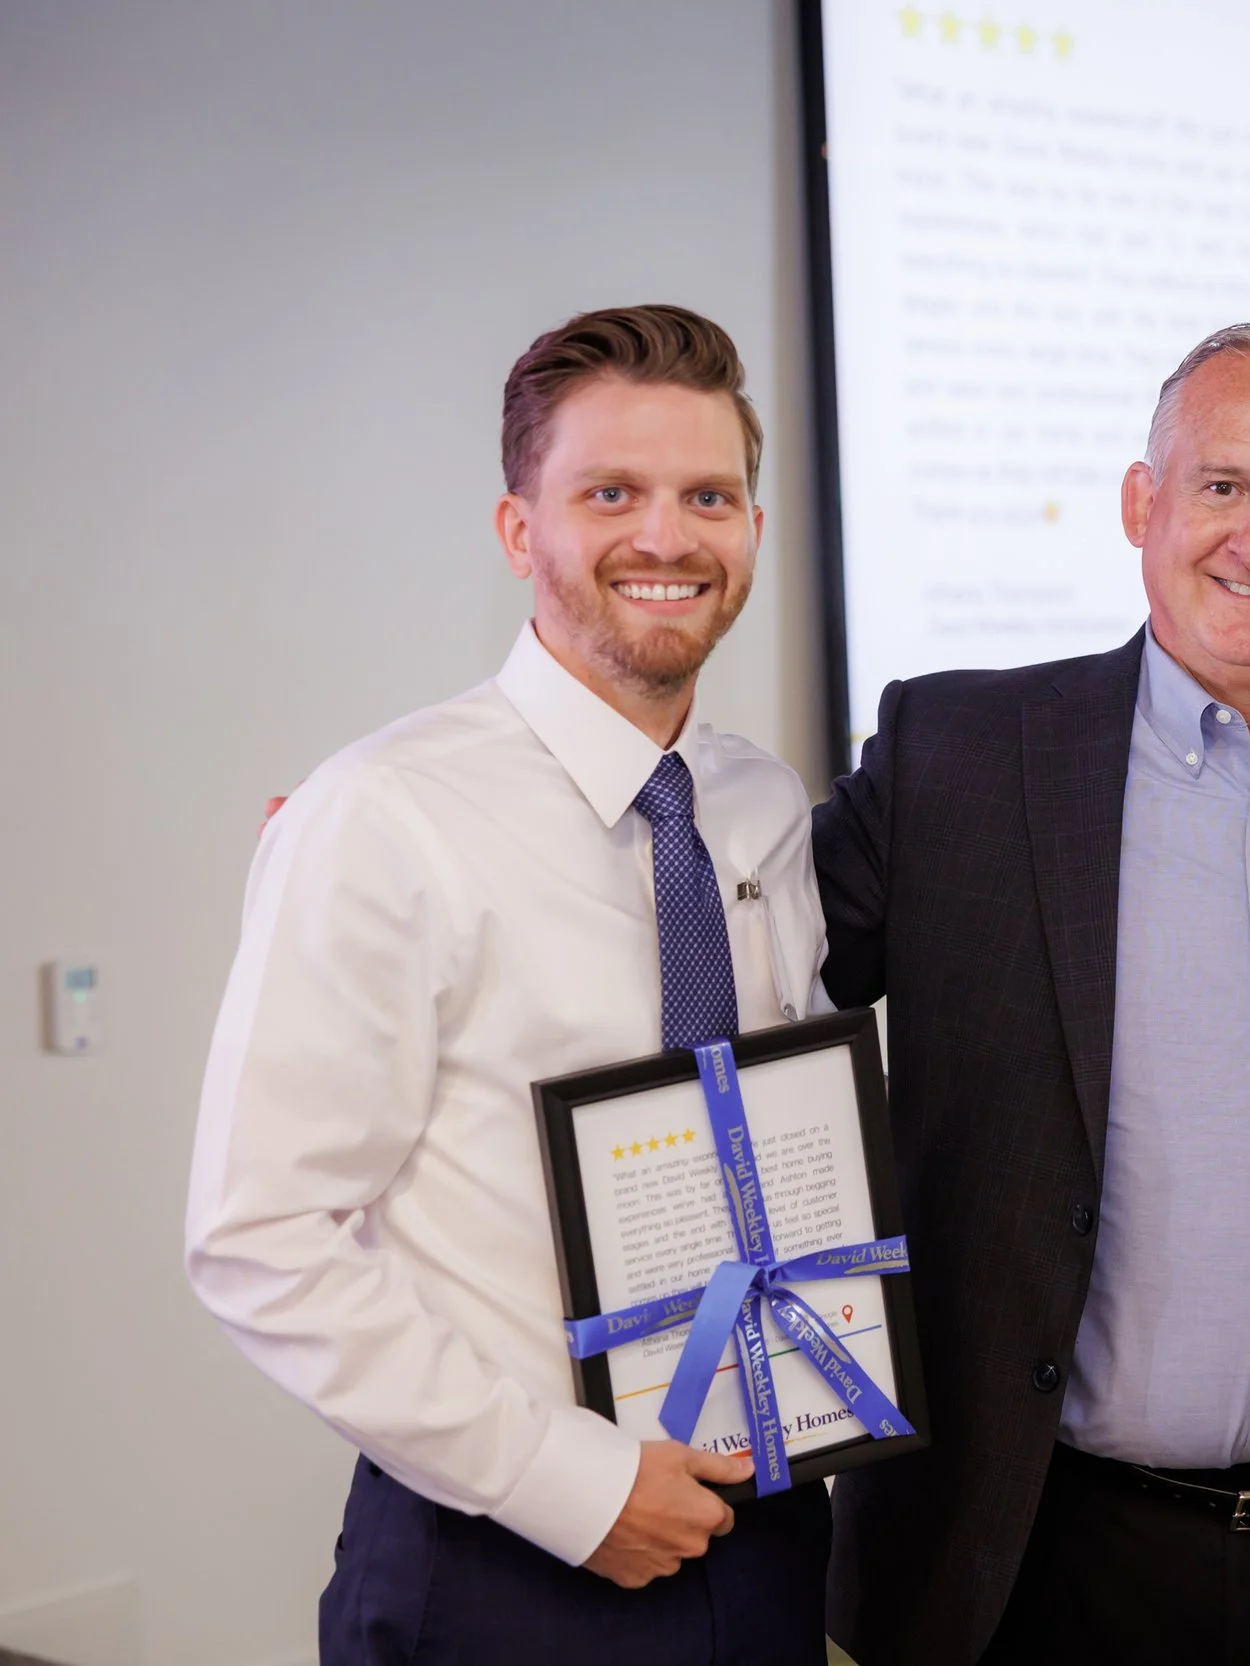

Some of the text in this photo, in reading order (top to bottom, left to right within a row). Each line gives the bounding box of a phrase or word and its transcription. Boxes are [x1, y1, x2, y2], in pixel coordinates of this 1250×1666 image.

[711, 1045, 730, 1094] omes
[780, 1129, 806, 1142] closed
[809, 1126, 820, 1134] on
[662, 1172, 686, 1184] David
[781, 1146, 795, 1156] are
[797, 1141, 815, 1152] over
[728, 1125, 754, 1179] David
[760, 1164, 778, 1175] best
[782, 1158, 804, 1169] home
[807, 1150, 833, 1164] buying
[780, 1171, 808, 1184] Ashton
[812, 1164, 835, 1176] made
[774, 1186, 805, 1200] through
[805, 1178, 836, 1192] begging
[802, 1191, 838, 1207] customer
[740, 1178, 765, 1253] Weekley
[802, 1212, 812, 1221] so
[814, 1204, 840, 1218] special
[772, 1230, 803, 1243] forward
[805, 1226, 814, 1236] to
[816, 1218, 843, 1233] getting
[687, 1267, 712, 1279] home
[783, 1237, 824, 1254] something
[826, 1231, 844, 1243] ever
[816, 1239, 908, 1266] David Week
[606, 1308, 651, 1334] Davi
[741, 1299, 780, 1482] avid Weekley Homes
[823, 1357, 863, 1405] David
[796, 1407, 855, 1432] Homes
